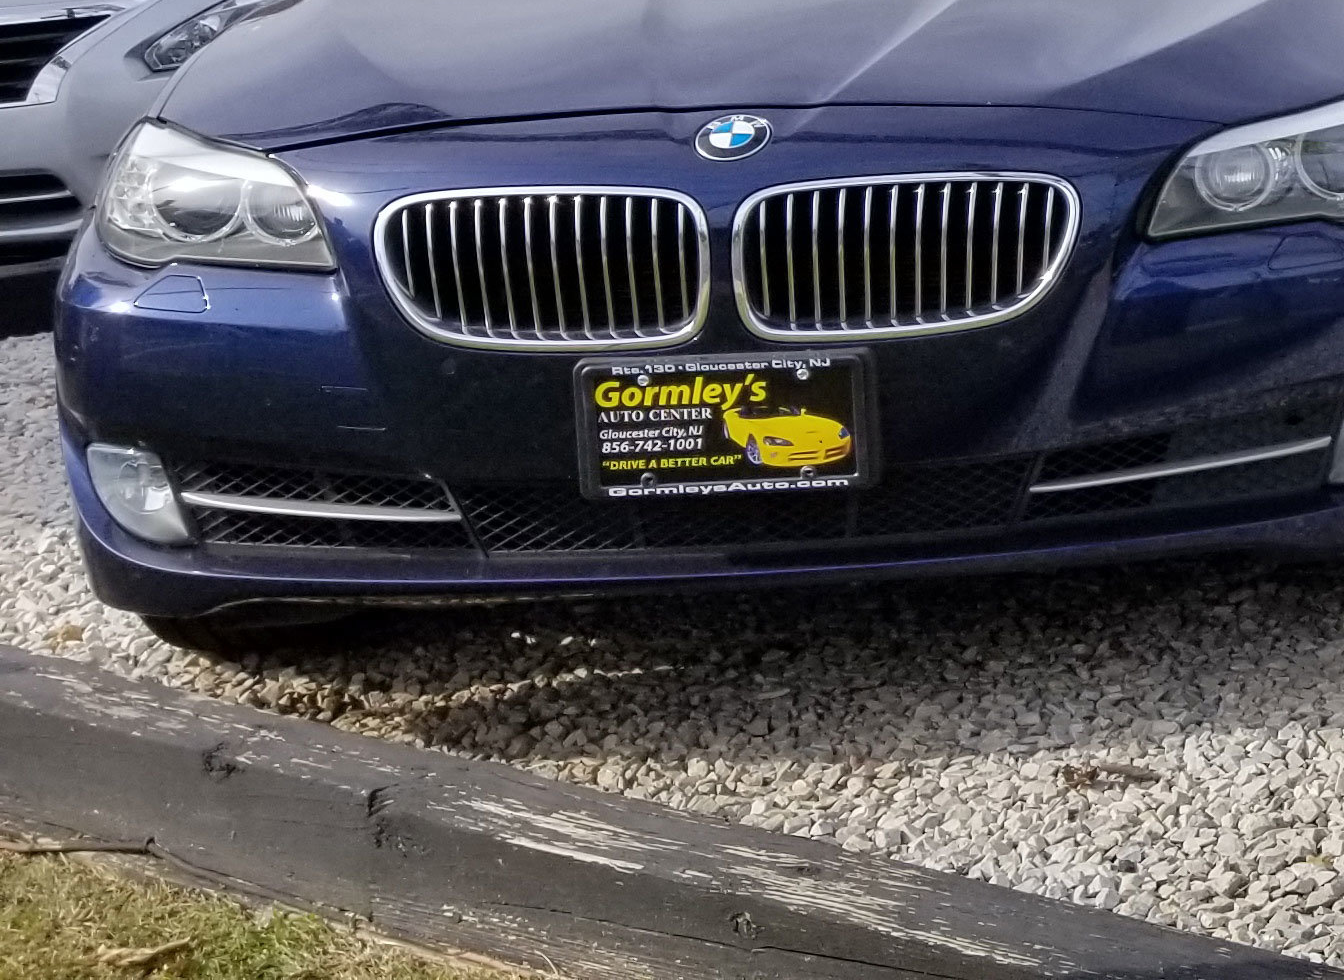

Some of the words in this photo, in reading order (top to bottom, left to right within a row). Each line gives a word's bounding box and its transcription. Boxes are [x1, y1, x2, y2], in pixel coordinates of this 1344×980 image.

[612, 366, 644, 376] Rte.
[646, 364, 677, 374] 130
[685, 360, 769, 372] Gloucester
[771, 358, 806, 370] City,
[810, 358, 831, 367] NJ
[594, 373, 767, 410] Gormley's
[598, 409, 644, 423] AUTO
[649, 407, 713, 421] CENTER
[599, 427, 661, 440] Gloucester
[662, 426, 687, 439] City,
[688, 425, 703, 436] NJ
[602, 438, 703, 454] 856-742-1001
[649, 459, 659, 468] A
[660, 457, 707, 468] BETTER
[608, 478, 849, 497] GormleysAuto.com
